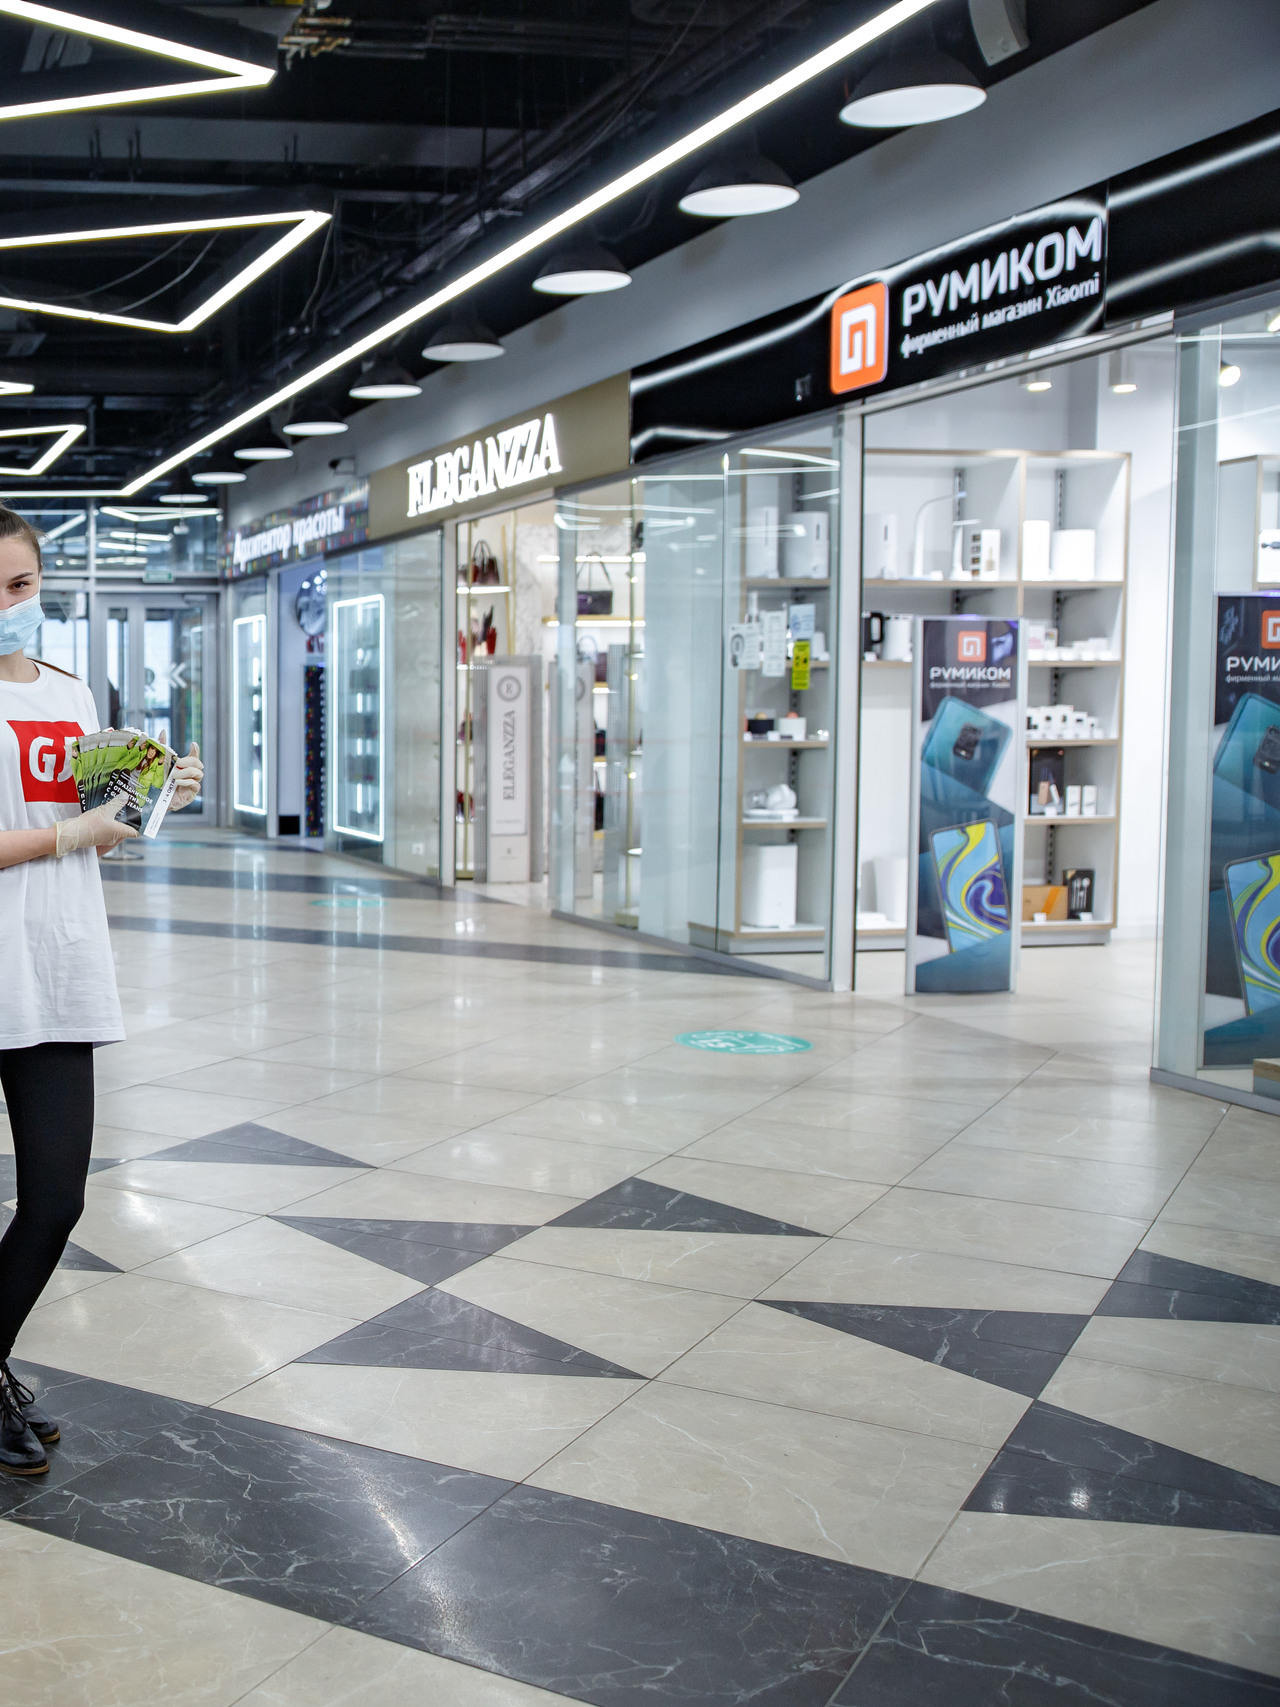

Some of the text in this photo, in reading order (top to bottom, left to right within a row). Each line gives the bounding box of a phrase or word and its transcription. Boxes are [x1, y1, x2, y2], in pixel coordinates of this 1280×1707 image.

[900, 271, 1100, 359] фирменный магазин Xiaomi
[902, 216, 1102, 327] РУМИКОМ
[406, 412, 563, 518] ELEGANZZA
[292, 505, 346, 556] красоты
[929, 667, 1012, 680] РУМИКОМ
[1226, 656, 1280, 672] РУМИ
[502, 709, 516, 800] ELEGANZZA
